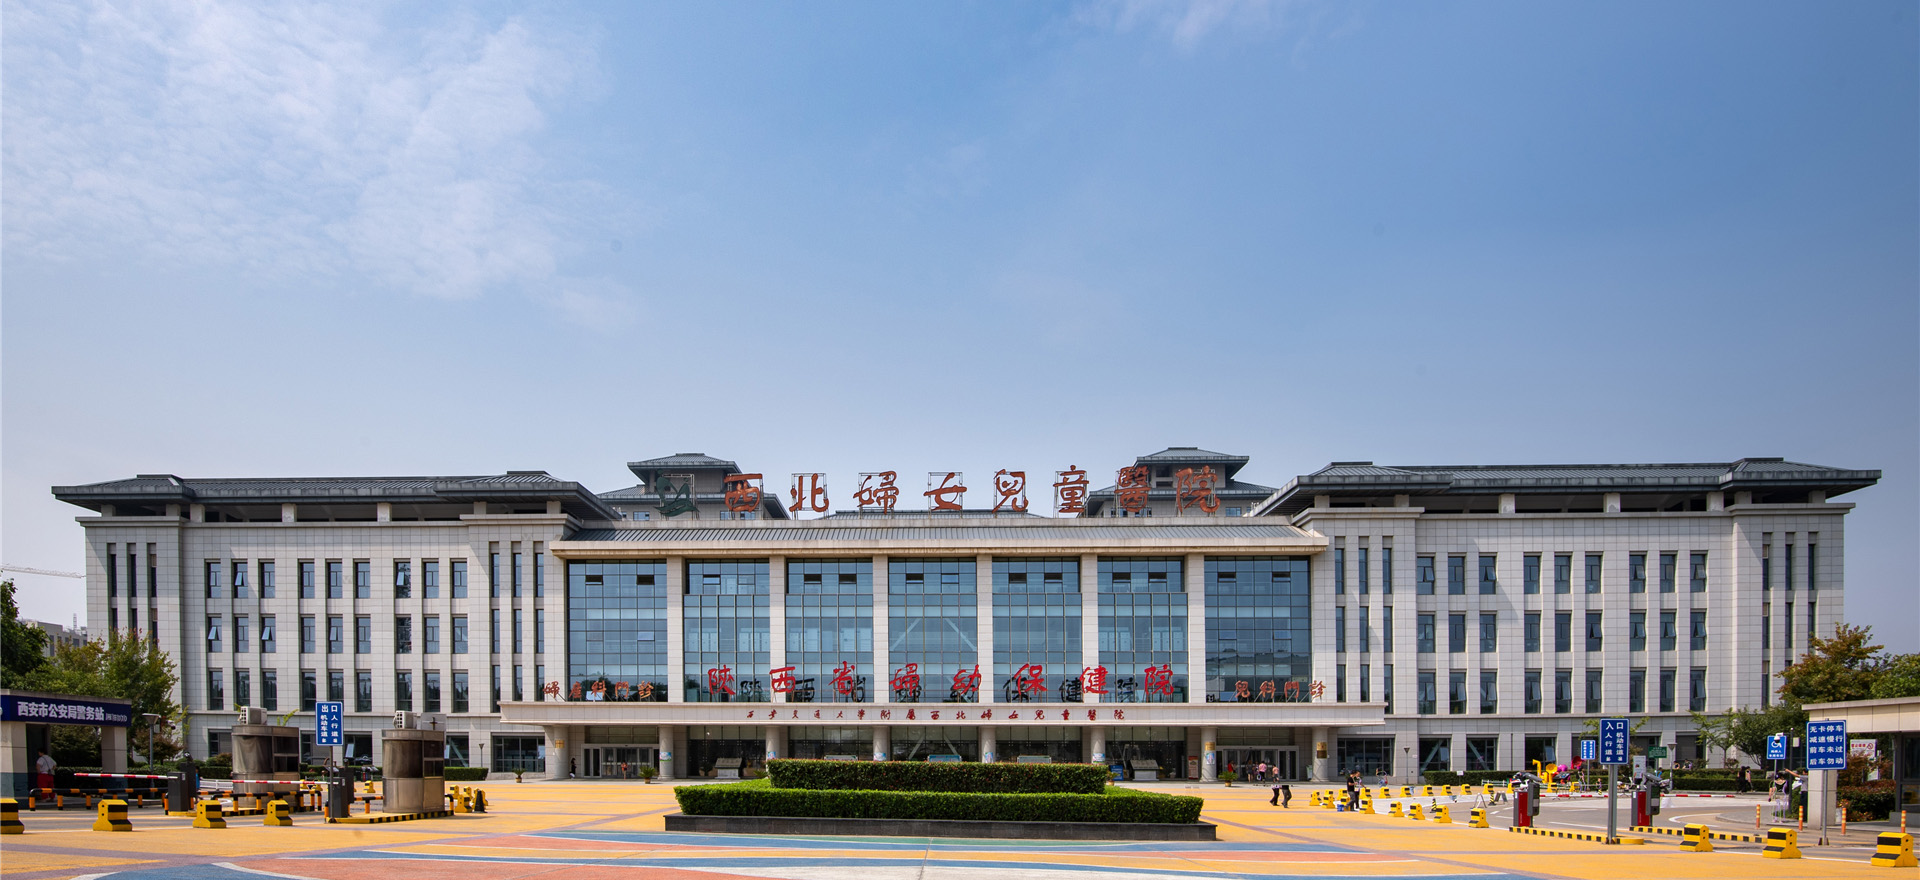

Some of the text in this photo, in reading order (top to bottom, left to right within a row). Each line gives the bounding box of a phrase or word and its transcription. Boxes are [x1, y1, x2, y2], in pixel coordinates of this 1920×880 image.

[724, 465, 1220, 514] 西北婦女兒童醫院
[707, 660, 1174, 697] 陝西省婦幼保健院
[1235, 680, 1327, 699] 兒科門診
[17, 701, 105, 721] 西安市公安局警务站
[331, 714, 339, 737] 人行道
[1605, 721, 1624, 730] 入口
[1604, 732, 1613, 755] 人行道
[1616, 732, 1624, 755] 机动车道
